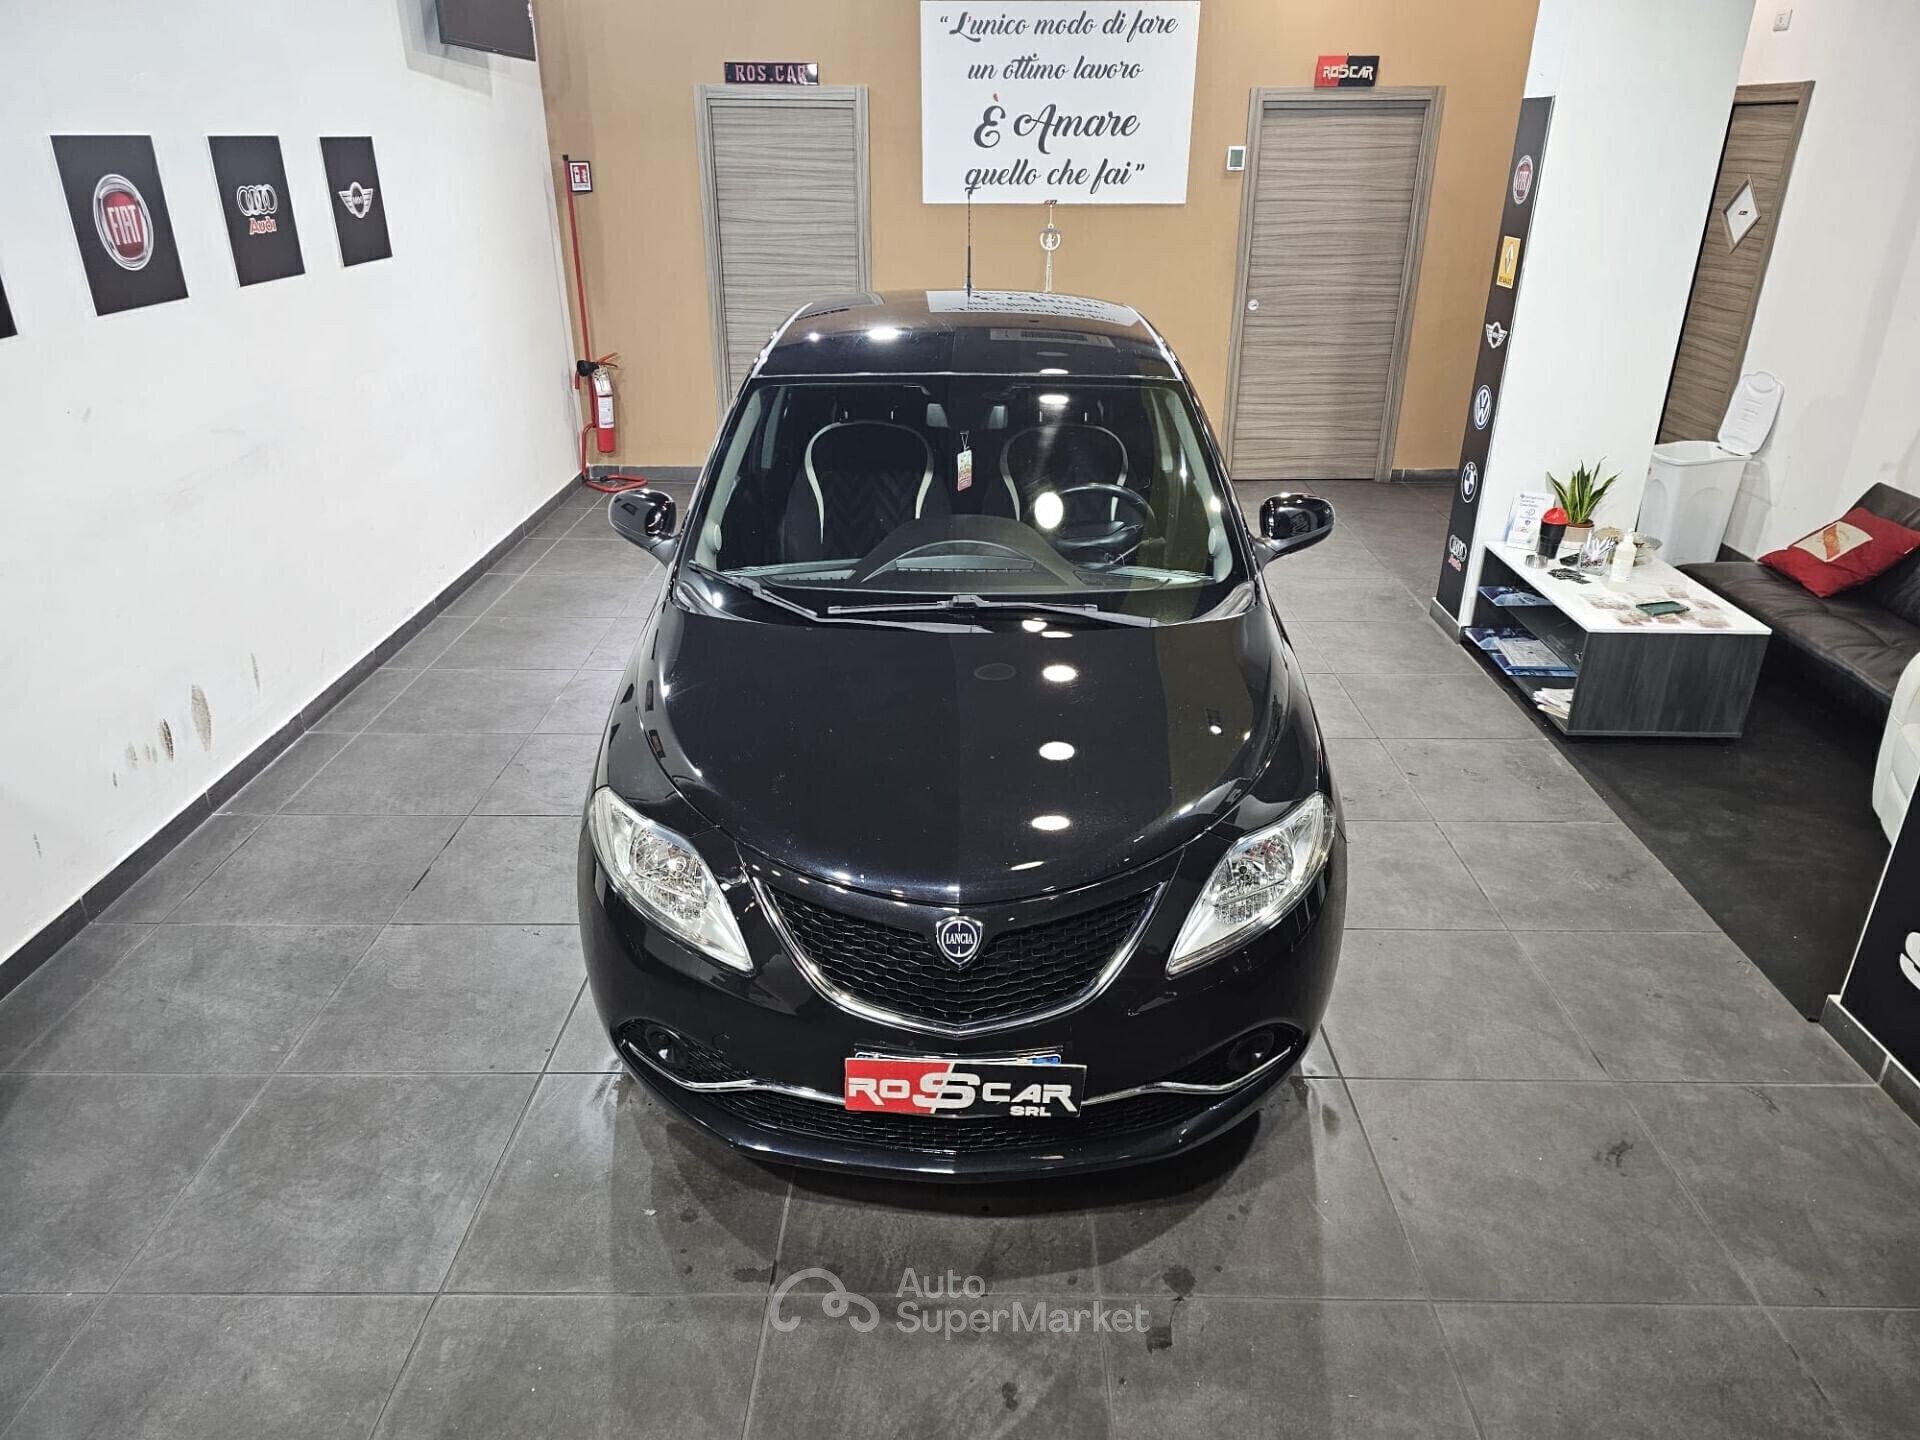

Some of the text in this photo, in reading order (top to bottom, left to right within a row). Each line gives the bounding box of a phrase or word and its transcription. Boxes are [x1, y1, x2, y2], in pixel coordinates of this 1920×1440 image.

[1033, 10, 1097, 35] modo
[1102, 10, 1127, 35] di
[1126, 9, 1179, 43] fare
[967, 53, 1144, 80] un ottimo lavoro
[973, 93, 1140, 155] È Amare
[964, 158, 1042, 195] quello
[1046, 158, 1091, 186] che
[106, 204, 142, 246] FIAT
[248, 216, 277, 235] Audi
[945, 933, 973, 945] LANCIA
[1009, 1106, 1051, 1118] SRL
